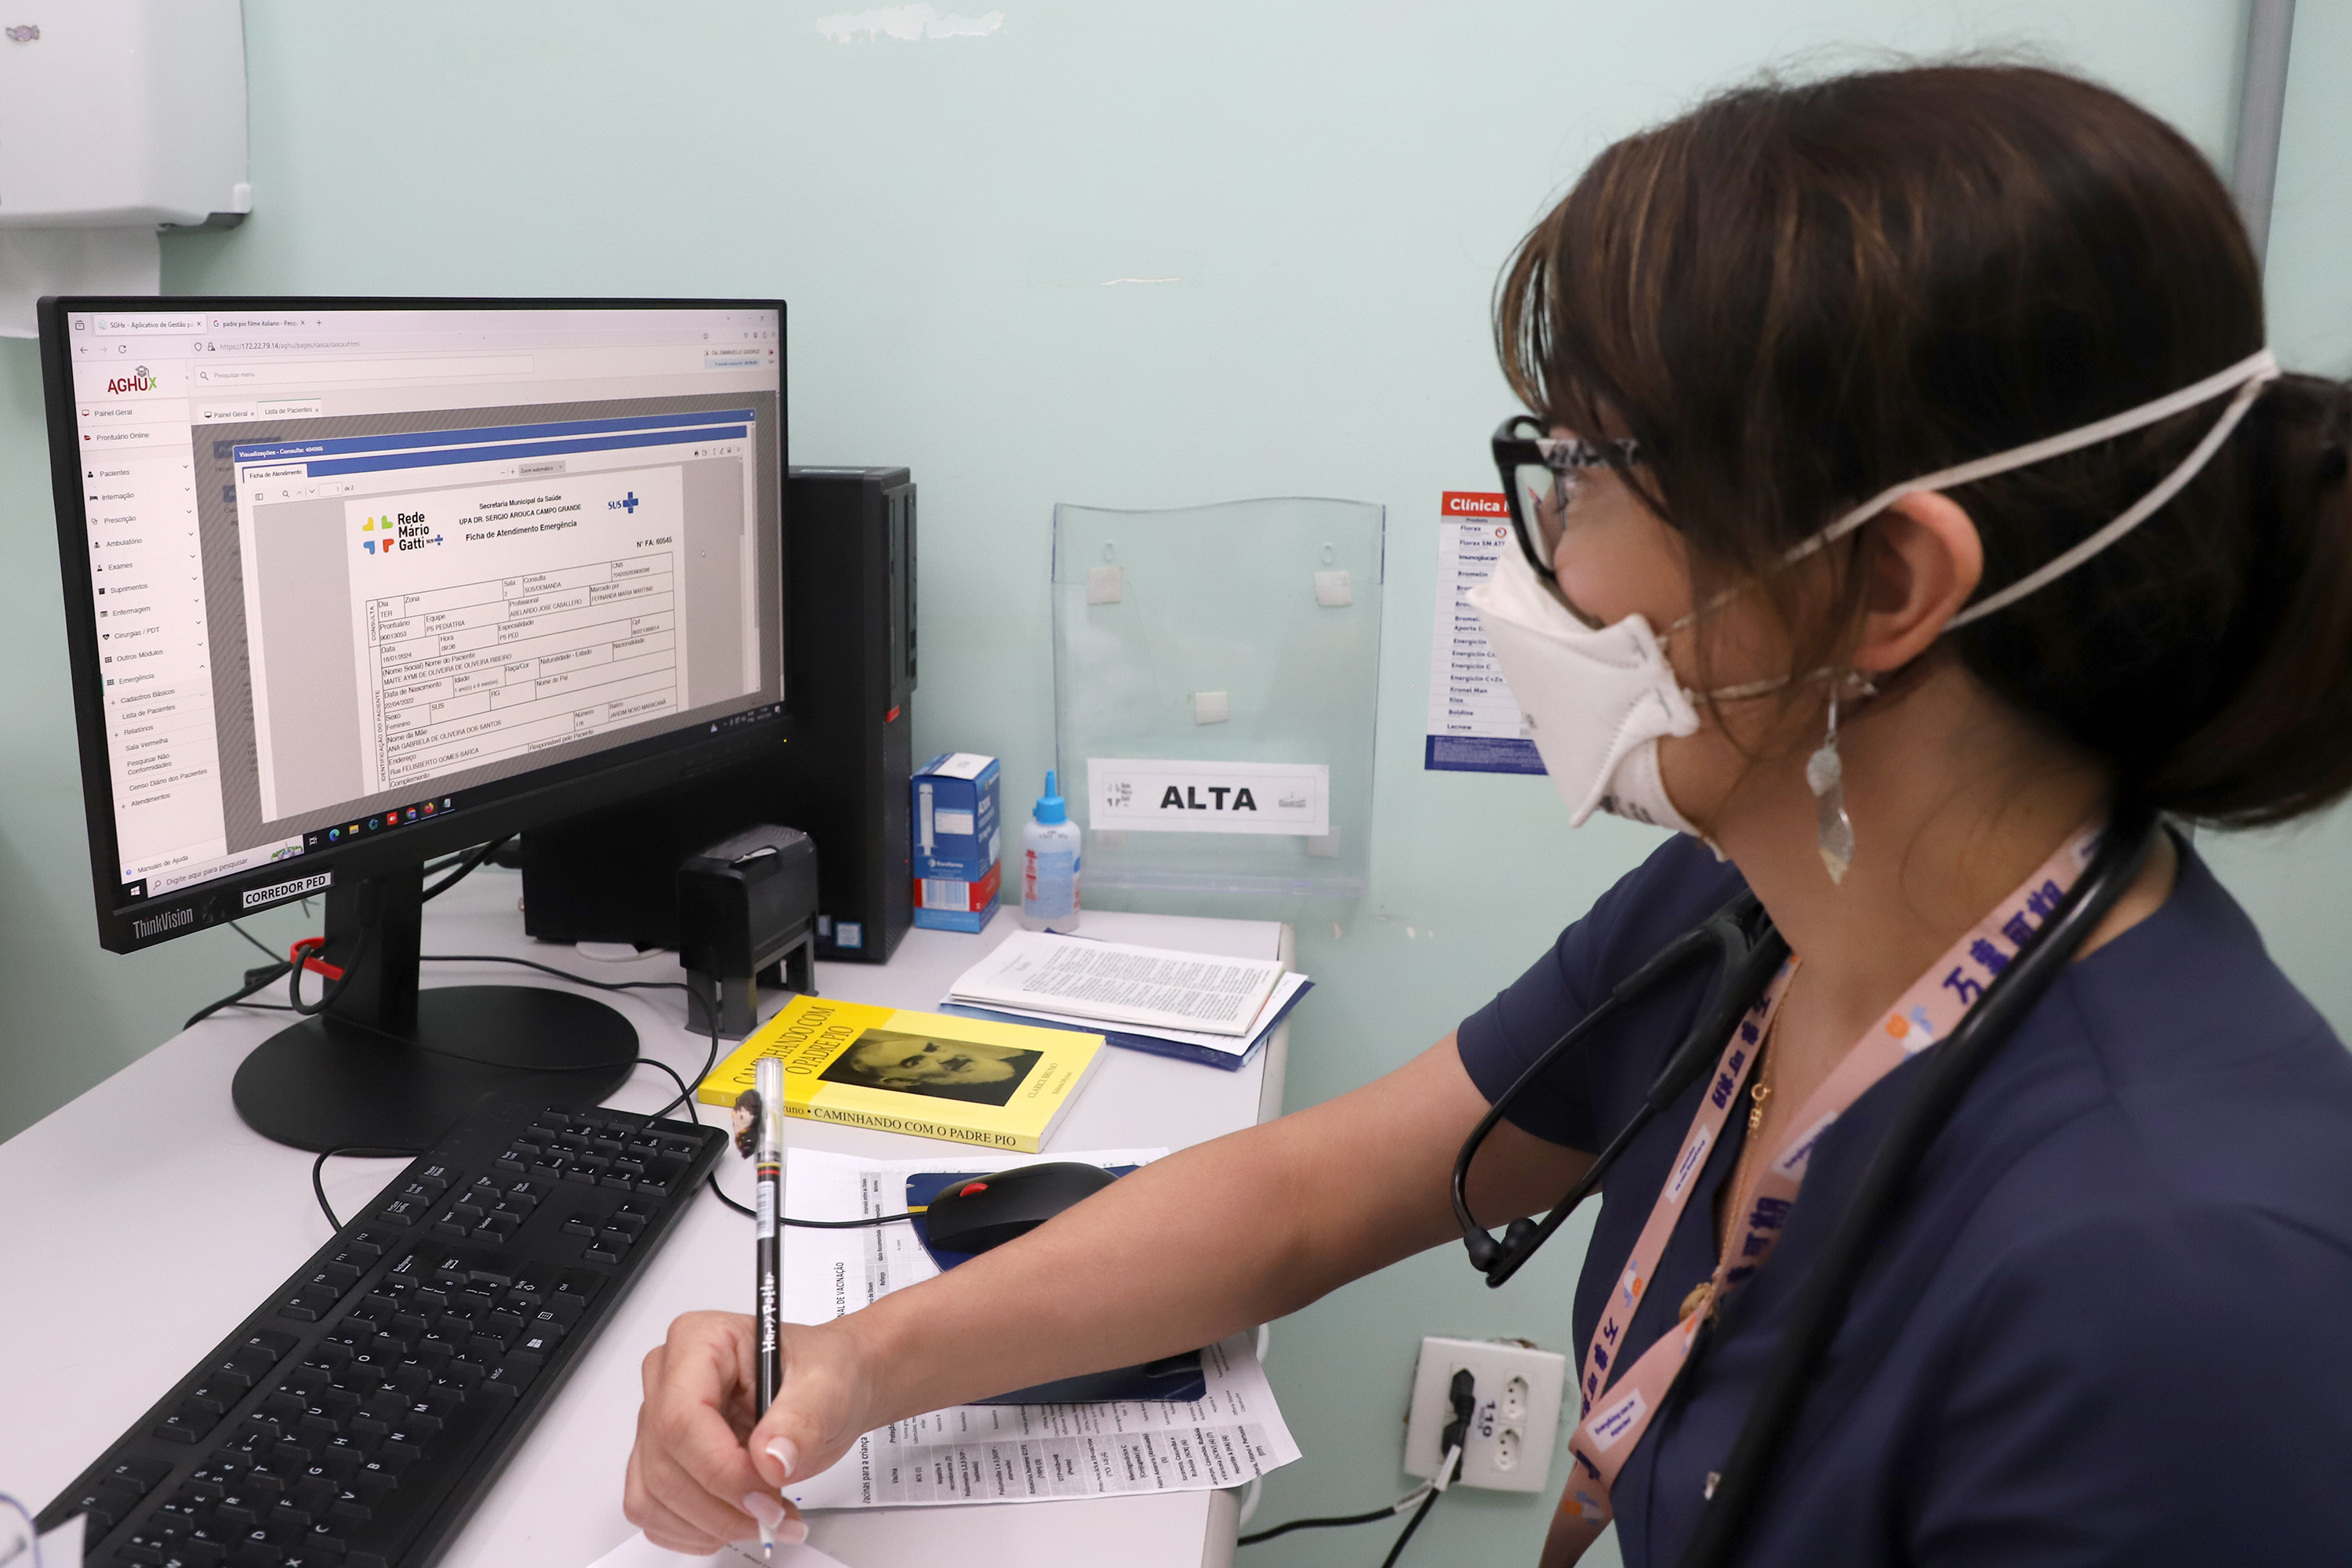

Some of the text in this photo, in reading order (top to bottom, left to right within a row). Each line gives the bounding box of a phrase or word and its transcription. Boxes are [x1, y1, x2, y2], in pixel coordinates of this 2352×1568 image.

[479, 500, 508, 510] Secretaria
[509, 498, 535, 506] Municipal
[608, 501, 622, 510] SUS
[1450, 498, 1501, 512] Clínica
[510, 510, 535, 519] AROUCA
[536, 506, 557, 515] CAMPO
[558, 504, 582, 513] GRANDE
[397, 512, 425, 525] Rede
[398, 524, 430, 539] Mário
[496, 525, 539, 537] Atendimento
[540, 520, 577, 532] Emergência
[107, 538, 143, 547] Ambulatório
[399, 539, 425, 551] Gatti
[524, 575, 546, 584] Consulta
[111, 583, 148, 593] Suprimentos
[590, 583, 611, 593] Marcado
[510, 597, 539, 607] Profissional
[113, 606, 151, 616] Enfermagem
[426, 614, 445, 622] Equipe
[436, 620, 465, 631] PEDIATRIA
[114, 630, 142, 639] Cirurgias
[139, 649, 163, 658] Módulos
[452, 652, 475, 662] Paciente
[119, 673, 154, 684] Emergência
[455, 675, 470, 684] Idade
[384, 681, 442, 699] Data Nascimento
[121, 692, 151, 703] Cadastros
[147, 705, 176, 714] Pacientes
[431, 702, 445, 711] SUS
[124, 725, 154, 735] Relatórios
[140, 738, 169, 748] Vermelha
[387, 734, 405, 743] Nome
[127, 757, 156, 767] Pesquisar
[389, 753, 417, 765] Endereço
[128, 761, 172, 775] Conformidades
[129, 782, 149, 791] Censo
[150, 778, 167, 786] Diário
[180, 768, 208, 779] Pacientes
[390, 772, 430, 787] Complemento
[131, 793, 171, 807] Atendimentos
[1160, 786, 1258, 811] ALTA
[137, 855, 189, 873] Manuais Ajuda
[166, 857, 249, 886] Digite aqui para pesquisar
[245, 876, 326, 904] CORREDOR PED
[132, 908, 194, 939] ThinkVision
[797, 1006, 836, 1027] COM
[785, 1025, 854, 1075] O PADRE PIO
[1042, 1063, 1058, 1079] BRUNO
[782, 1105, 1016, 1147] runo CAMINHANDO COM O PADRE PIO
[356, 1232, 369, 1242] F12
[834, 1261, 846, 1294] VACINAÇÃO
[760, 1271, 777, 1353] Harry Potter
[414, 1403, 429, 1413] M
[333, 1437, 348, 1446] H
[859, 1437, 869, 1459] criança
[862, 1466, 872, 1480] para
